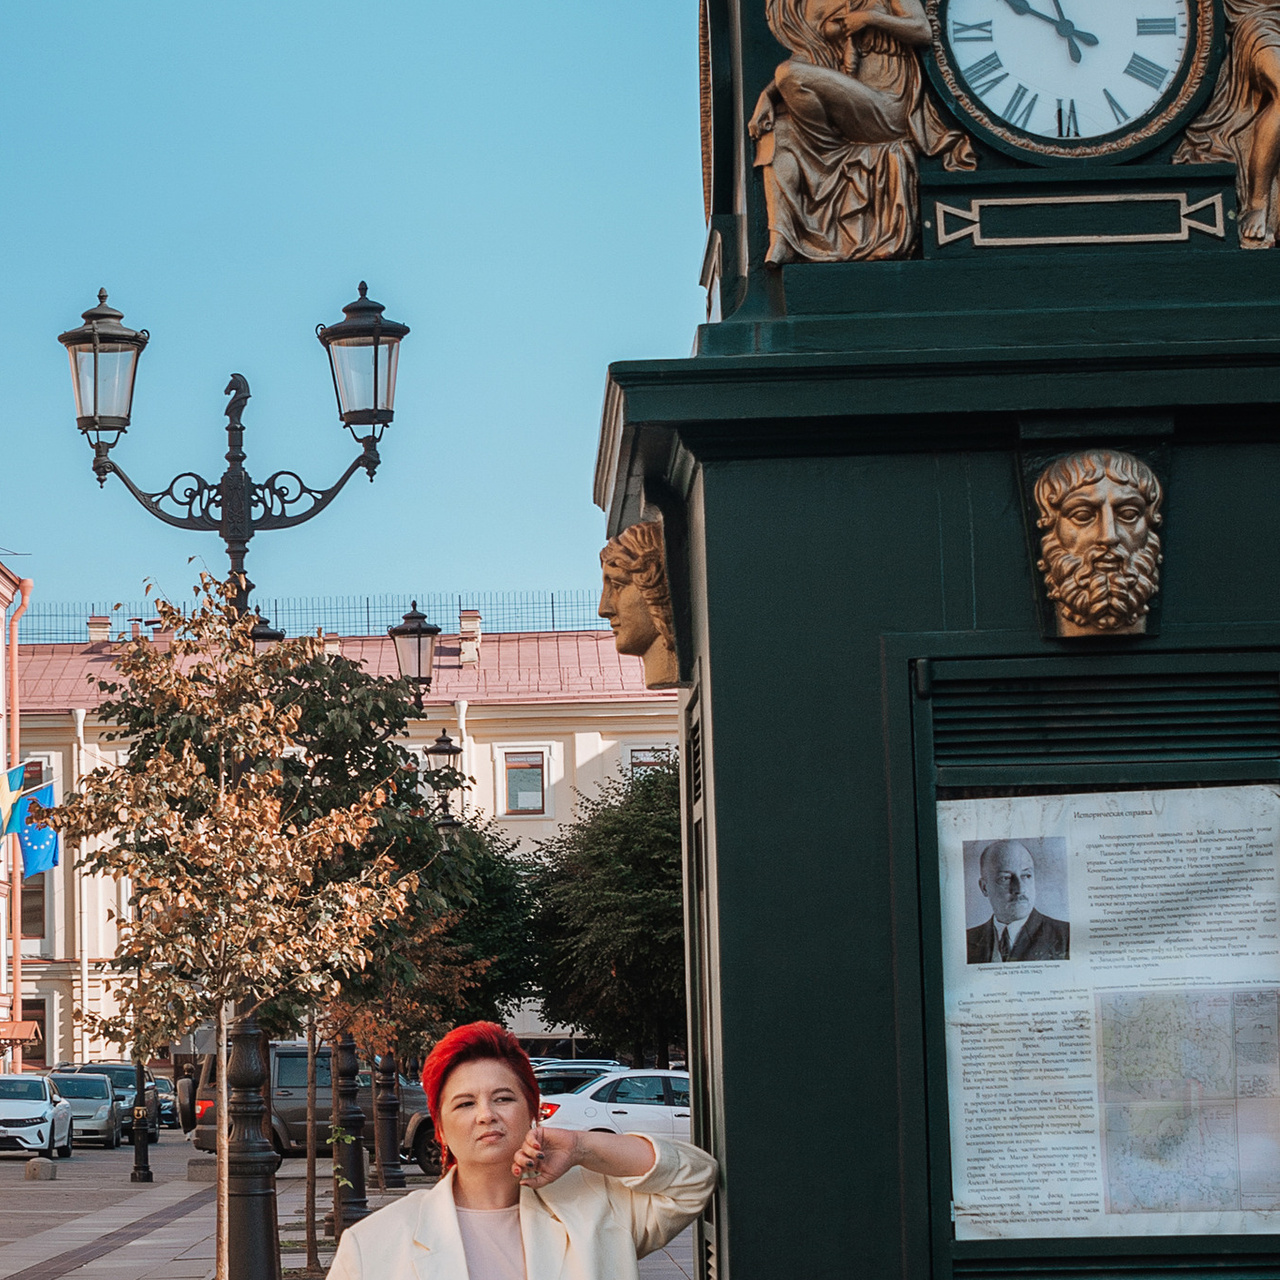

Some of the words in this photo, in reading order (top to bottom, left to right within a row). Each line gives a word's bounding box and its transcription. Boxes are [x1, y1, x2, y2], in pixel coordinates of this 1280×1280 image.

[953, 19, 993, 43] IX
[1136, 17, 1177, 36] III
[962, 50, 1010, 98] VIII
[1123, 52, 1169, 91] IIII
[1001, 83, 1038, 130] VII
[1055, 98, 1080, 138] VI
[1103, 88, 1130, 125] V
[1074, 809, 1124, 821] Историческая
[1125, 810, 1153, 818] справка
